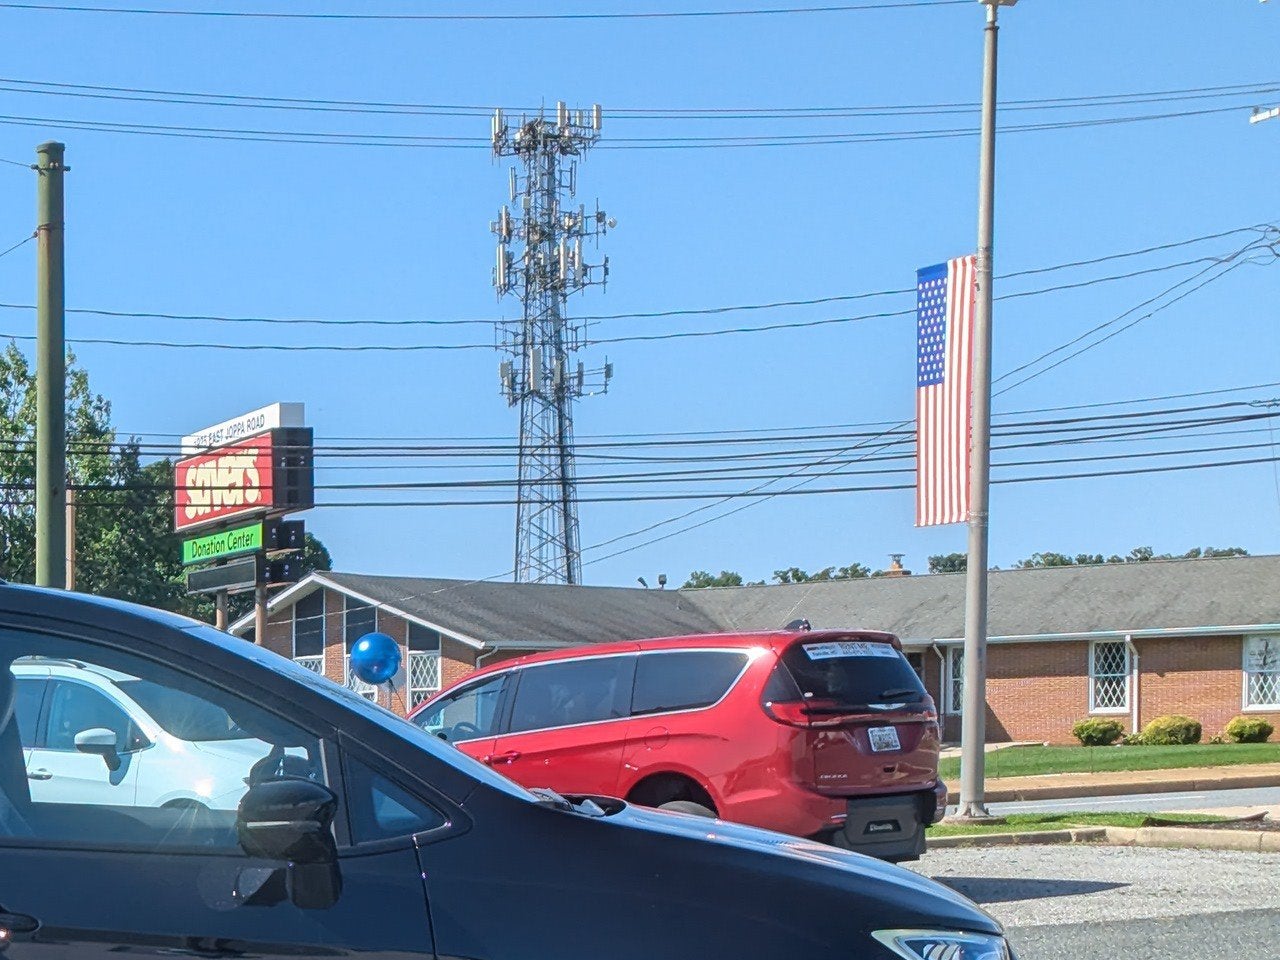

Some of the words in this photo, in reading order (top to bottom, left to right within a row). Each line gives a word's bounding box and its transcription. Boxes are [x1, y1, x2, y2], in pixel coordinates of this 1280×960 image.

[209, 429, 223, 445] EAST
[225, 421, 245, 440] JOPPA
[246, 414, 265, 432] ROAD
[192, 537, 225, 558] Donation
[228, 532, 254, 550] Center
